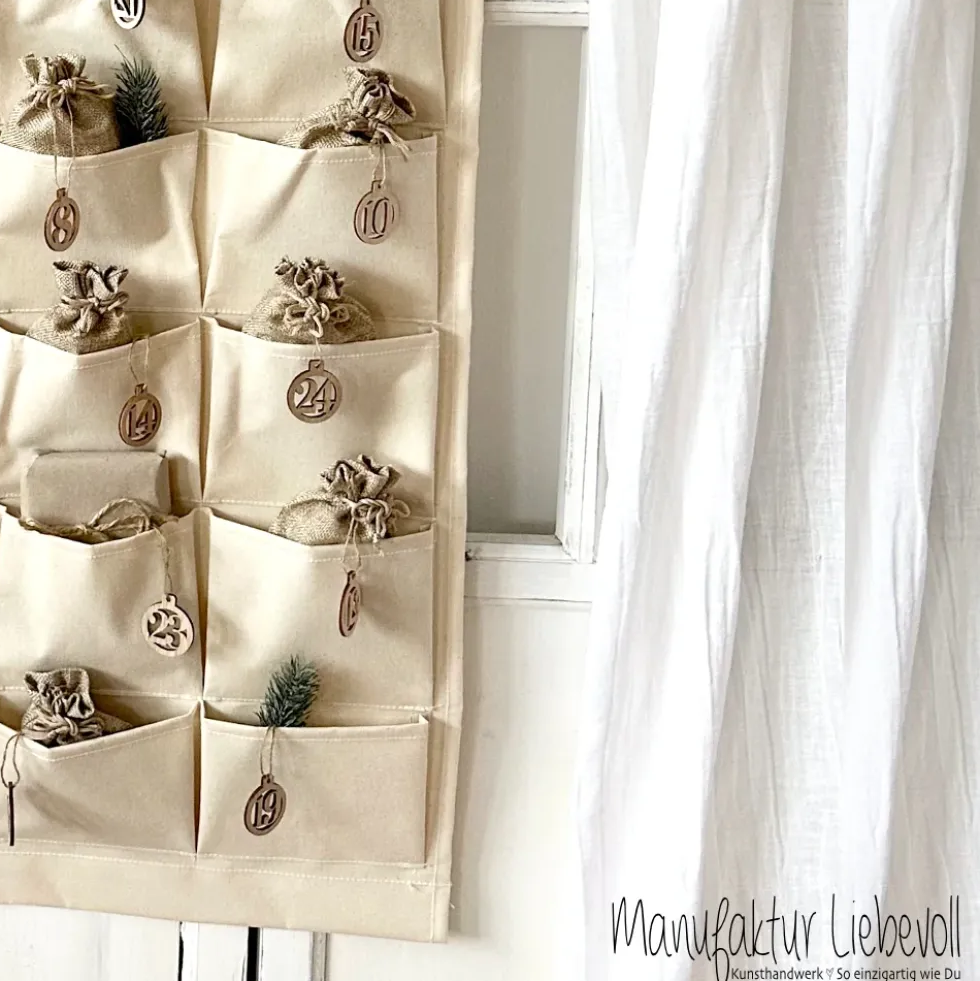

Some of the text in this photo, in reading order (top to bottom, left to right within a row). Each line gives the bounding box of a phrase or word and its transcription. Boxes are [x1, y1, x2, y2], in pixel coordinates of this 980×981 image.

[350, 13, 378, 53] 15
[362, 198, 389, 236] 10
[292, 377, 335, 415] 24
[127, 402, 157, 439] 14
[149, 610, 183, 649] 23
[253, 789, 279, 827] 19
